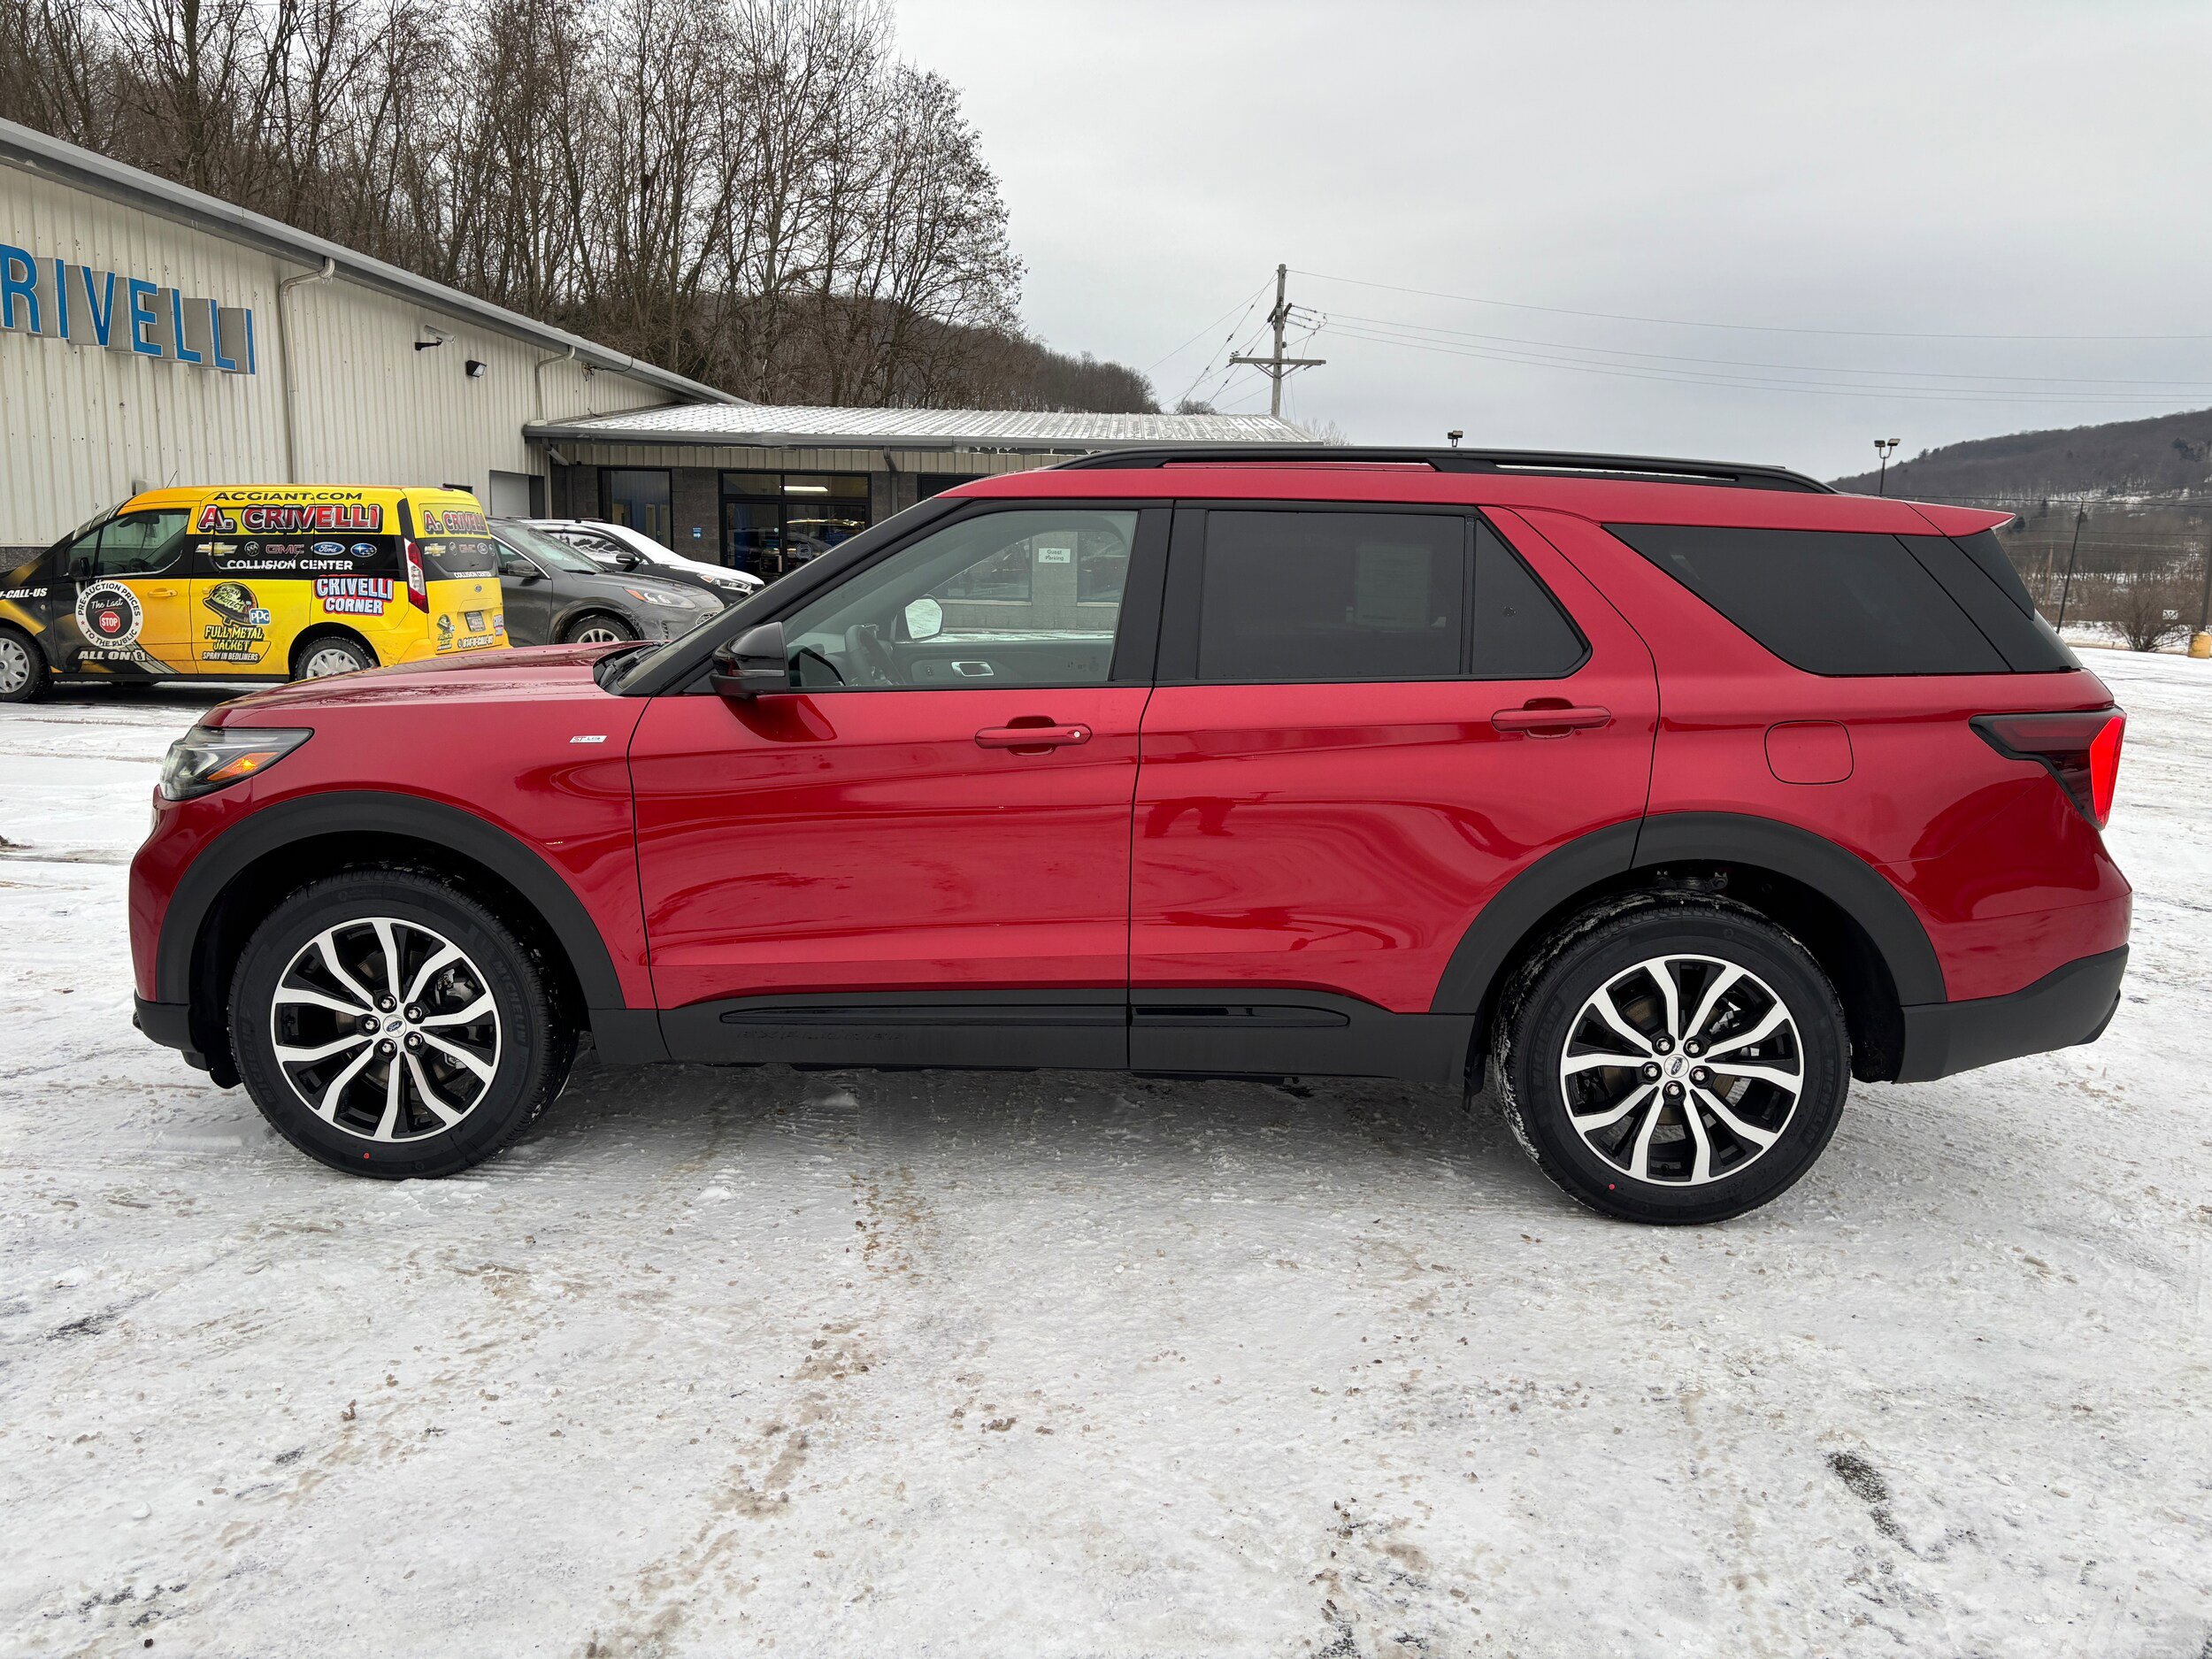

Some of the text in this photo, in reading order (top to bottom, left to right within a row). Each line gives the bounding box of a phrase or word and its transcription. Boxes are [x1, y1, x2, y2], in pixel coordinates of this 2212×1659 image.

[0, 243, 256, 375] RIVELLI
[213, 492, 363, 501] ACGIANT.COM
[198, 504, 381, 532] A. CRIVELLI
[265, 544, 304, 554] GMC
[227, 559, 353, 571] COLLISION CENTER
[316, 578, 393, 600] CRIVELLI
[78, 582, 141, 617] PRE-AUCTION PRICES
[106, 597, 123, 608] Last
[216, 594, 244, 610] PROTECT
[326, 597, 383, 613] CORNER
[102, 618, 118, 627] STOP
[250, 611, 269, 623] PPG
[85, 628, 137, 647] TO THE PUBLIC
[204, 626, 264, 639] FULL METAL
[213, 639, 251, 651] JACKET
[78, 650, 104, 661] ALL
[108, 651, 131, 661] ON
[203, 651, 258, 661] SPRAY IN BEDLINERS
